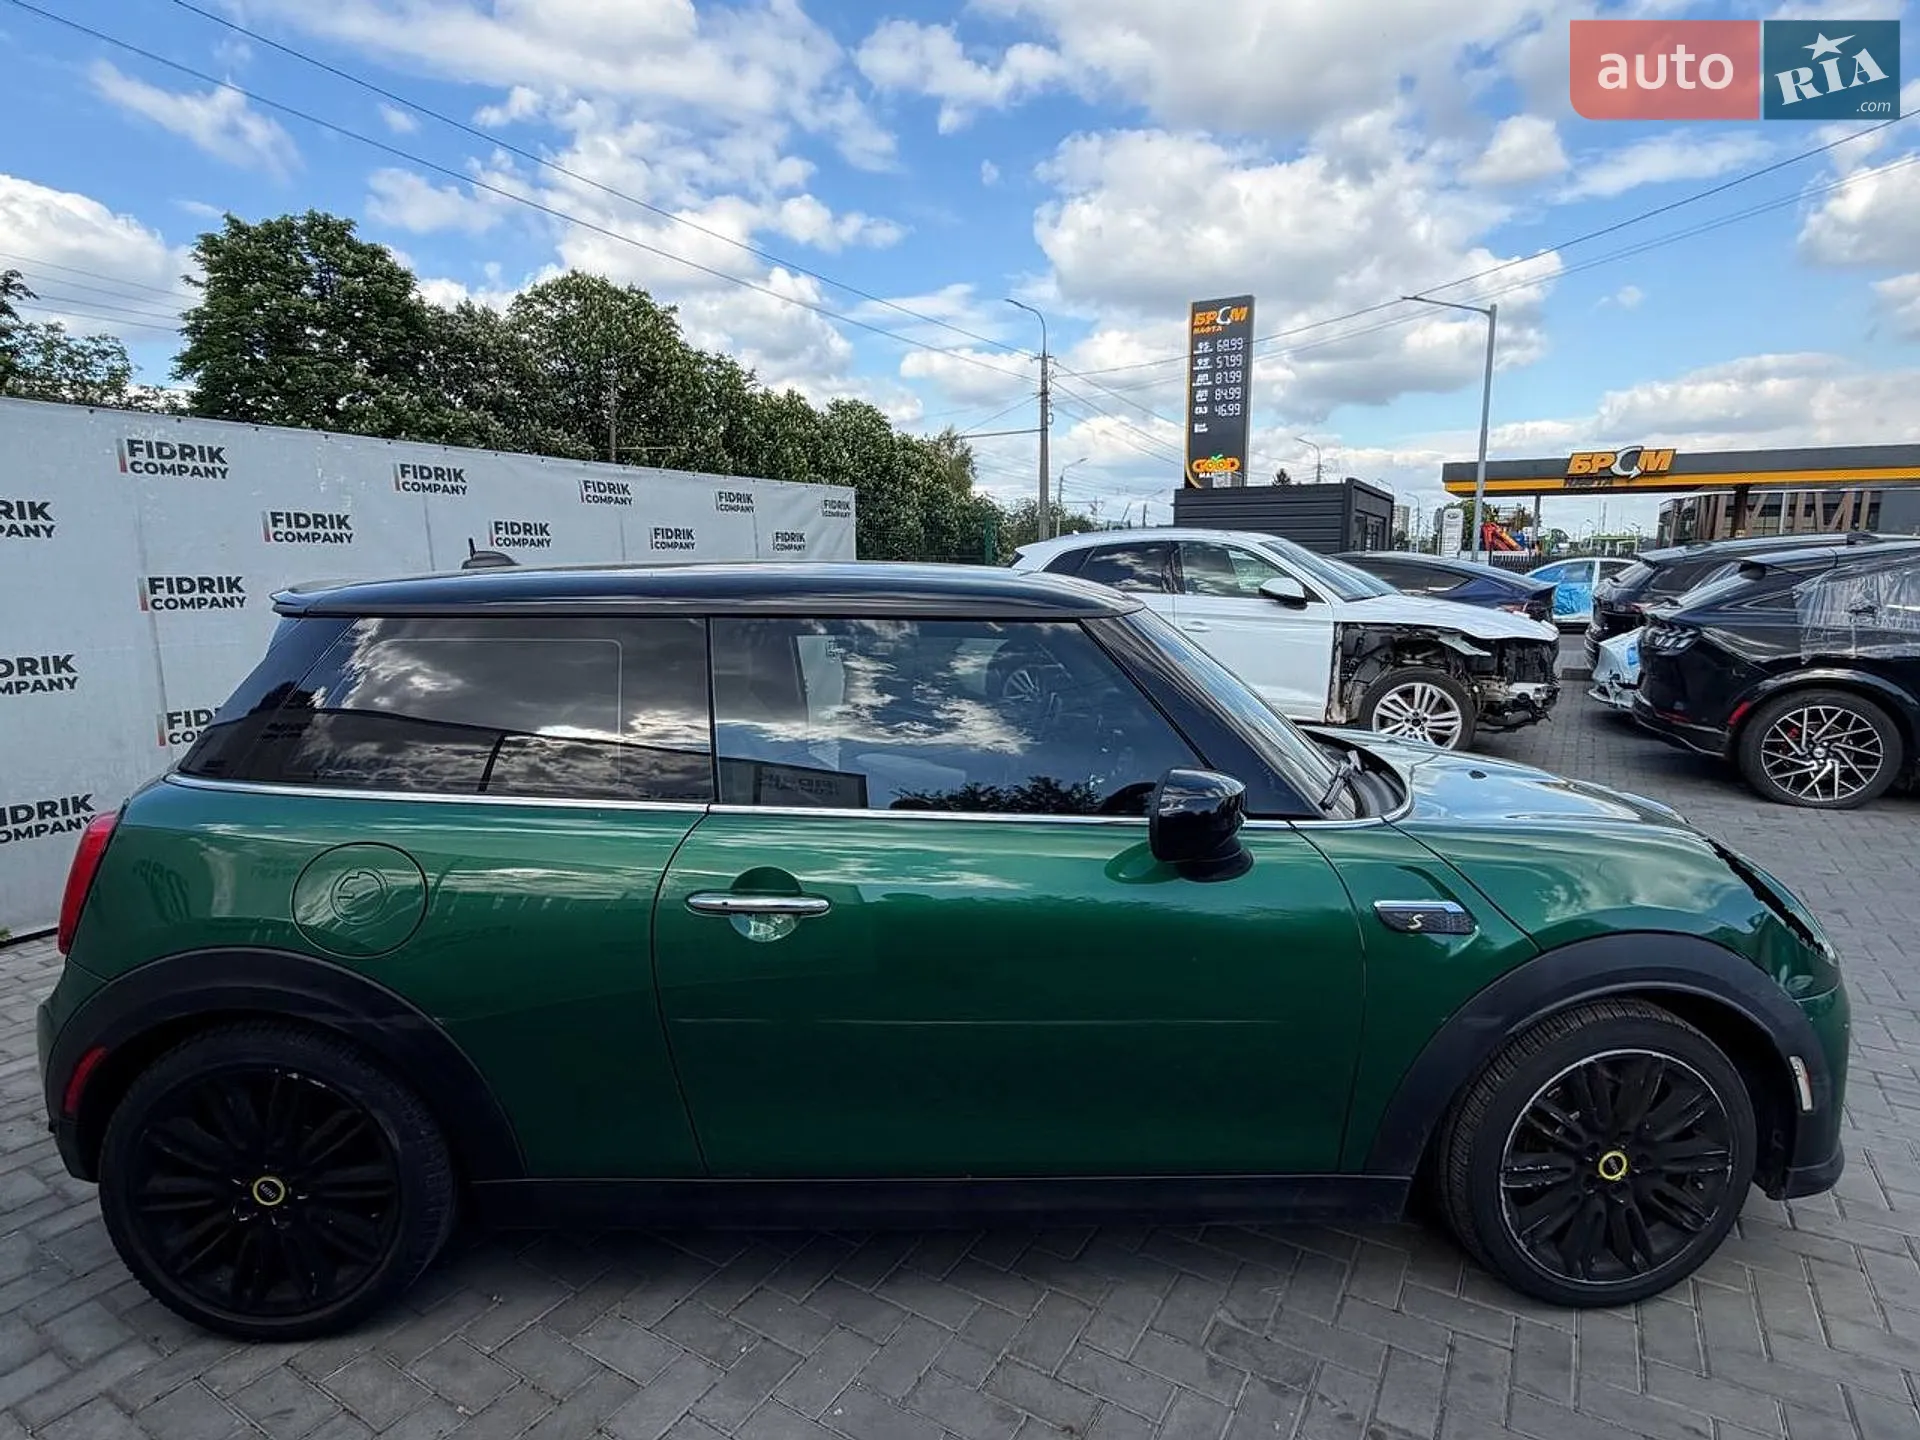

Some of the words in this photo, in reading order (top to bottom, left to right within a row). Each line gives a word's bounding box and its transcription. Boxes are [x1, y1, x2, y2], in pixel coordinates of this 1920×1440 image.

[127, 439, 226, 465] FIDRIK
[129, 460, 229, 480] COMPANY
[1567, 446, 1674, 479] БРСМ
[400, 463, 466, 483] FIDRIK
[402, 480, 468, 496] COMPANY
[584, 480, 631, 495] FIDRIK
[585, 493, 633, 506] COMPANY
[718, 491, 753, 504] FIDRIK
[0, 500, 55, 521] RIK
[270, 512, 352, 531] FIDRIK
[494, 521, 551, 537] FIDRIK
[273, 530, 354, 544] COMPANY
[495, 535, 551, 548] COMPANY
[654, 528, 695, 540] FIDRIK
[775, 532, 805, 542] FIDRIK
[654, 541, 695, 550] COMPANY
[148, 576, 244, 595] FIDRIK
[151, 595, 246, 611] COMPANY
[0, 654, 77, 678] DRIK
[166, 709, 214, 730] FID
[0, 793, 95, 827] IDRIK
[1408, 913, 1424, 929] S
